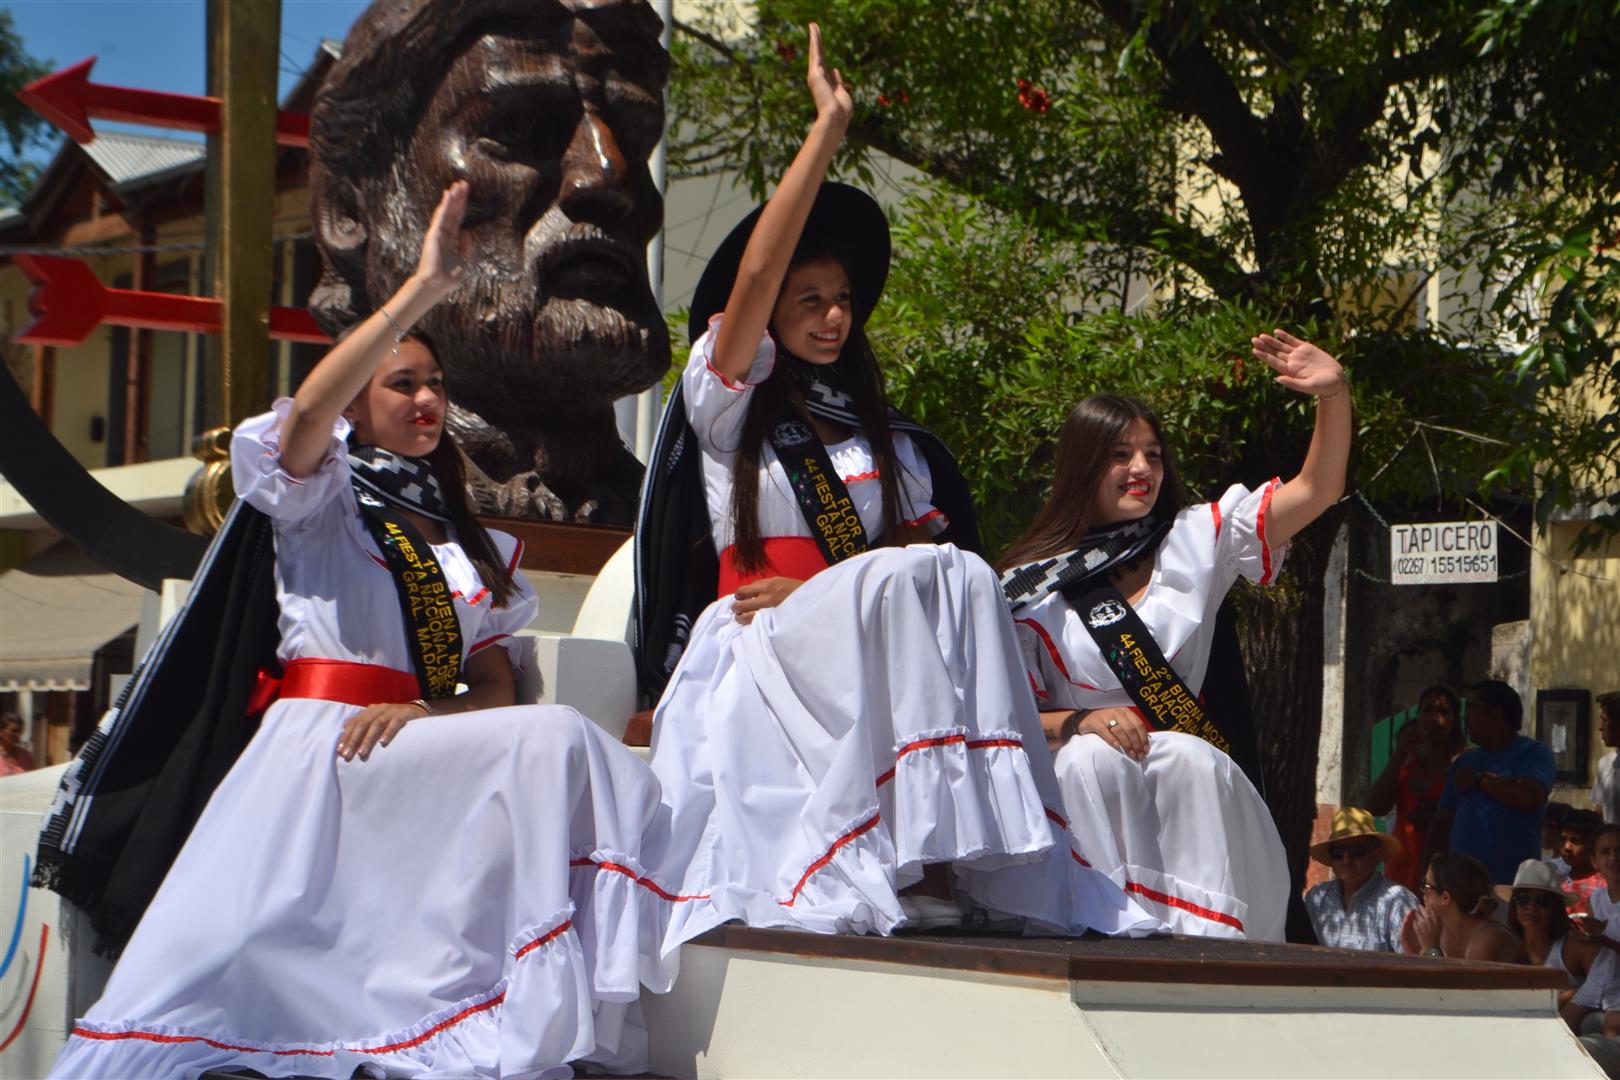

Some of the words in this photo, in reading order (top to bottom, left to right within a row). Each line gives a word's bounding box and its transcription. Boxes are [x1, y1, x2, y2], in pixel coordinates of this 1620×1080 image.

[804, 457, 817, 474] 44
[812, 473, 840, 523] FIESTA
[833, 522, 857, 558] NACI
[838, 497, 863, 538] FLOR
[816, 514, 841, 561] GRAL.
[1396, 524, 1492, 554] TAPICERO
[394, 535, 428, 582] FIESTA
[419, 585, 449, 664] NACIONAL
[402, 570, 422, 623] GRAL.
[431, 582, 459, 643] BUENA
[446, 653, 460, 689] MOZ
[1119, 633, 1136, 650] 44
[1129, 647, 1161, 694] FIESTA
[1139, 686, 1168, 724] GRAL.
[1169, 683, 1205, 721] BUENA
[1202, 720, 1231, 753] MOZA
